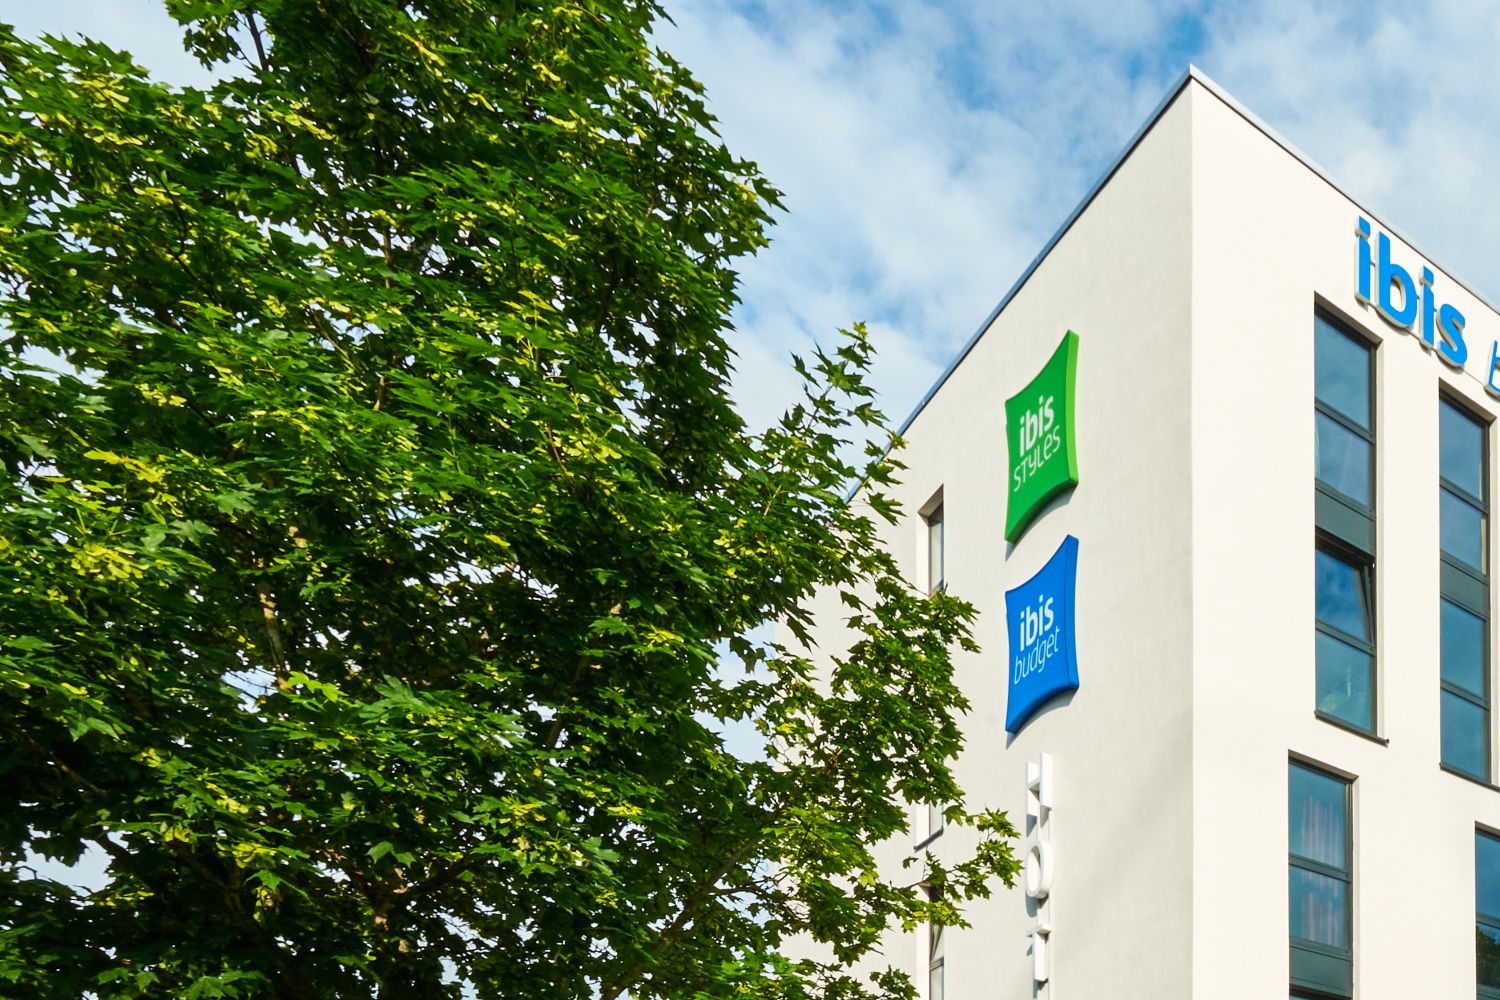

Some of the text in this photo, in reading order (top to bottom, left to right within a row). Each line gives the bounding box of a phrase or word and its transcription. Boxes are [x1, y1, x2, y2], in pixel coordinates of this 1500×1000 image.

[1355, 215, 1468, 368] ibis
[1020, 394, 1054, 458] ibis
[1020, 593, 1054, 652] ibis
[1014, 625, 1060, 685] budget
